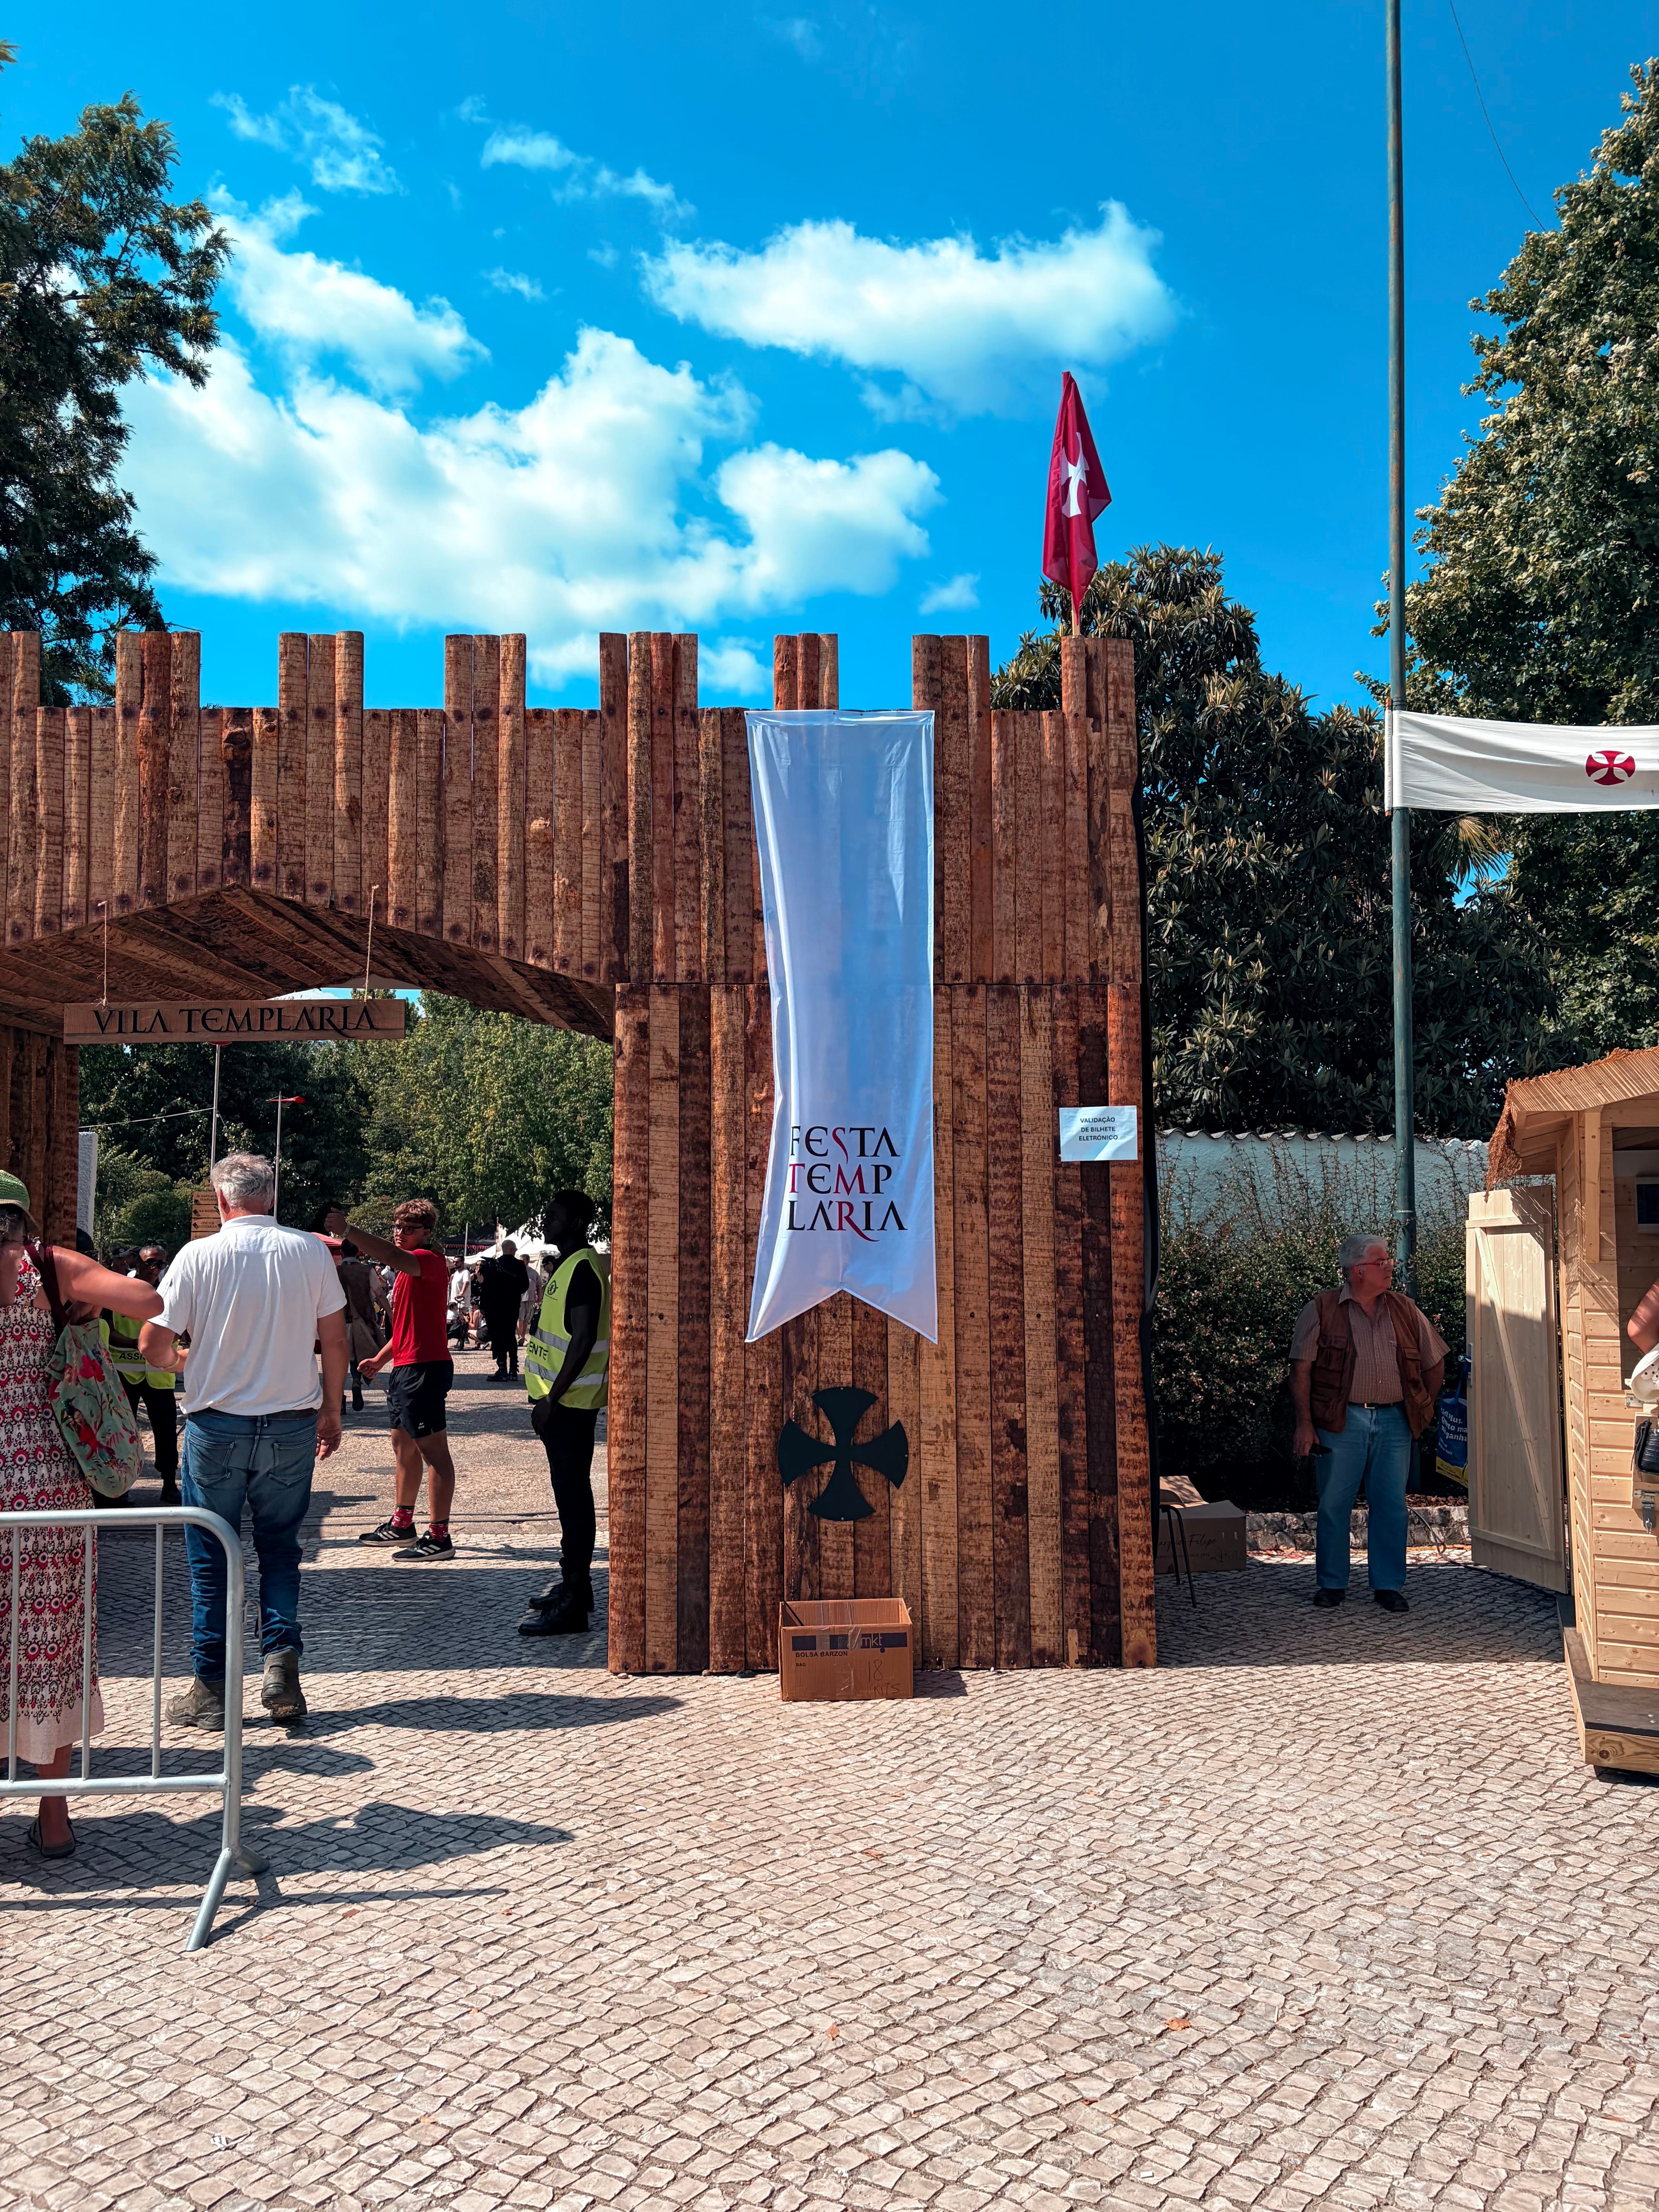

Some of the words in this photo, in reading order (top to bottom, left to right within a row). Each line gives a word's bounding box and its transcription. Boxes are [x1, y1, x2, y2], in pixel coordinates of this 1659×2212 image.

[92, 1010, 170, 1034] VILA
[790, 1125, 901, 1164] FESTA
[789, 1163, 892, 1195] TEMP
[787, 1200, 908, 1242] LÁRIA
[868, 1659, 883, 1683] 18
[874, 1683, 901, 1697] KITS
